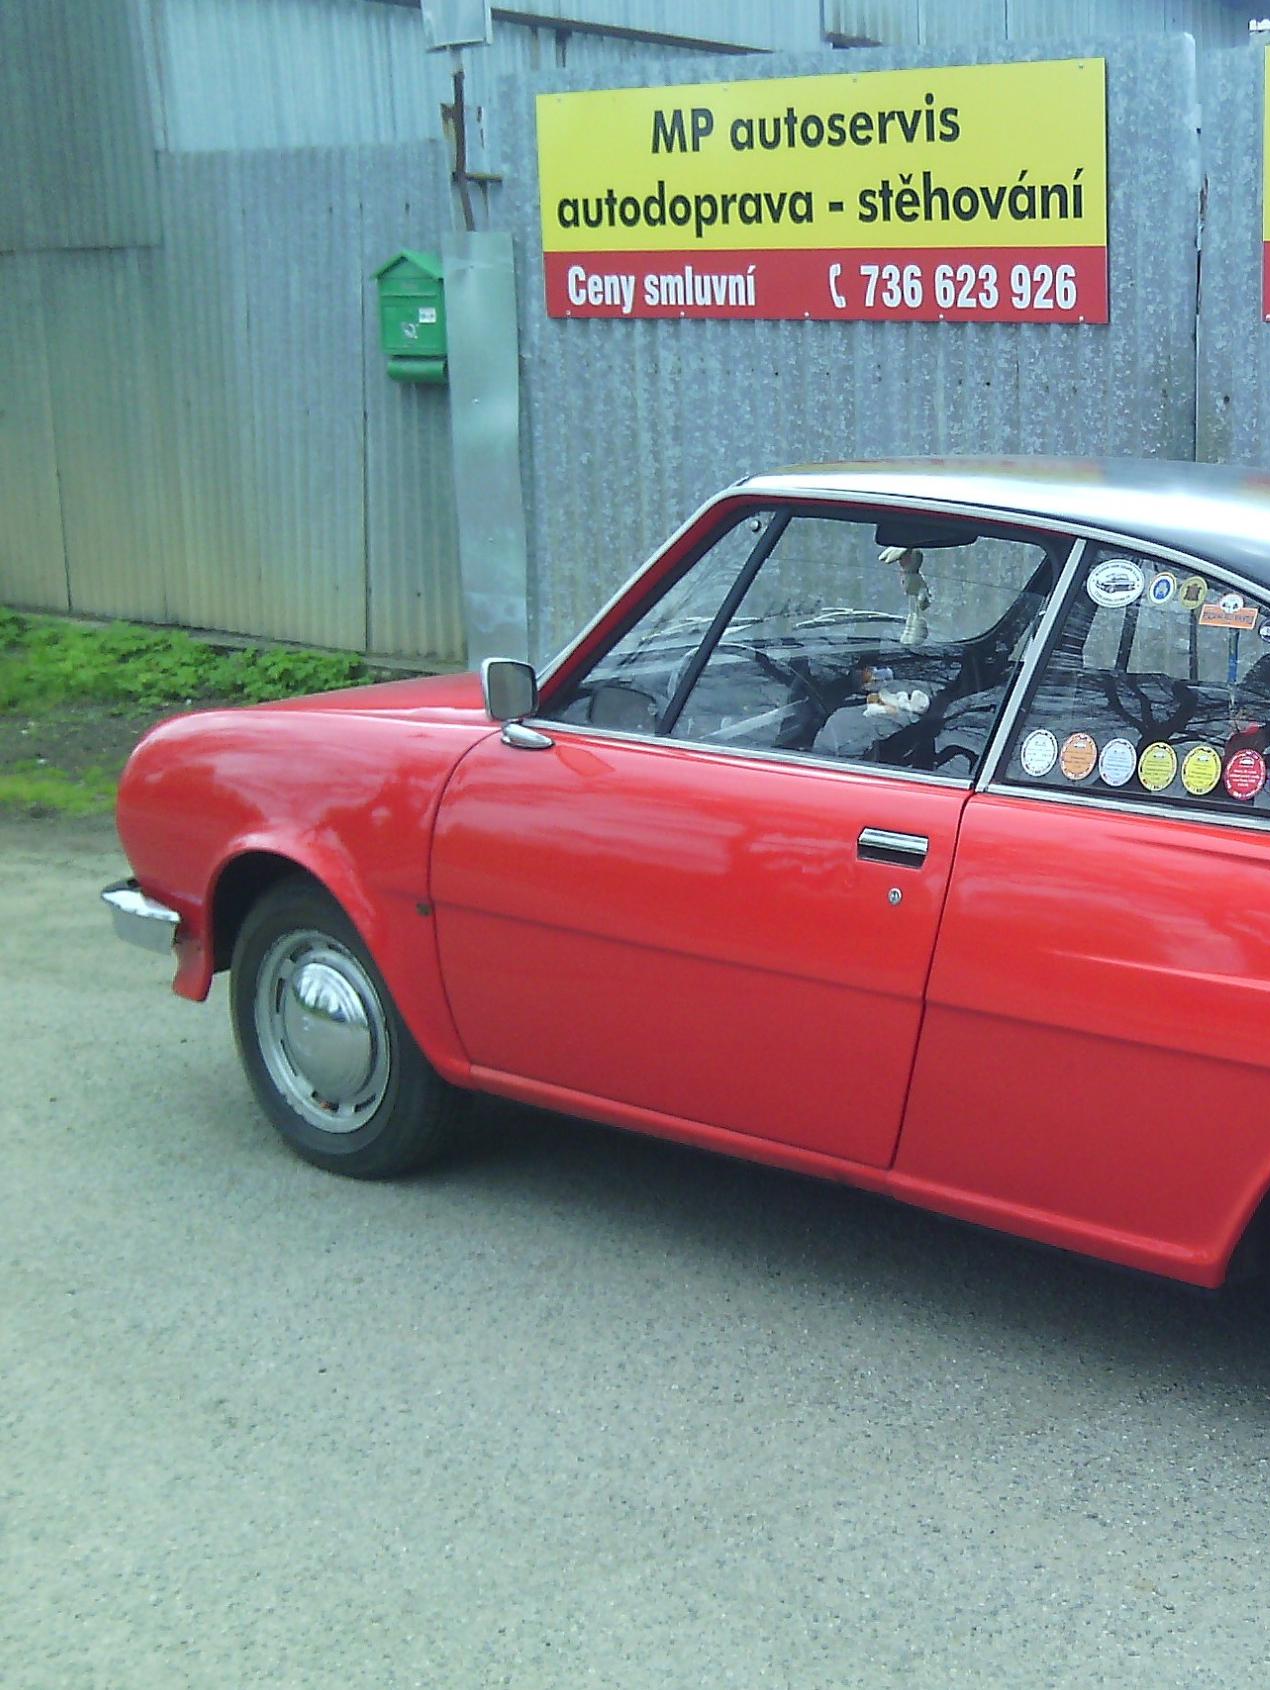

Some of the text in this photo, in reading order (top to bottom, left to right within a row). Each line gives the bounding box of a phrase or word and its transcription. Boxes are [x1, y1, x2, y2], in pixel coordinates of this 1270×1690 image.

[651, 93, 960, 154] MP autoservis
[557, 168, 1084, 238] autodoprava - stěhování
[567, 264, 1077, 313] Ceny smluvní 736 623 926
